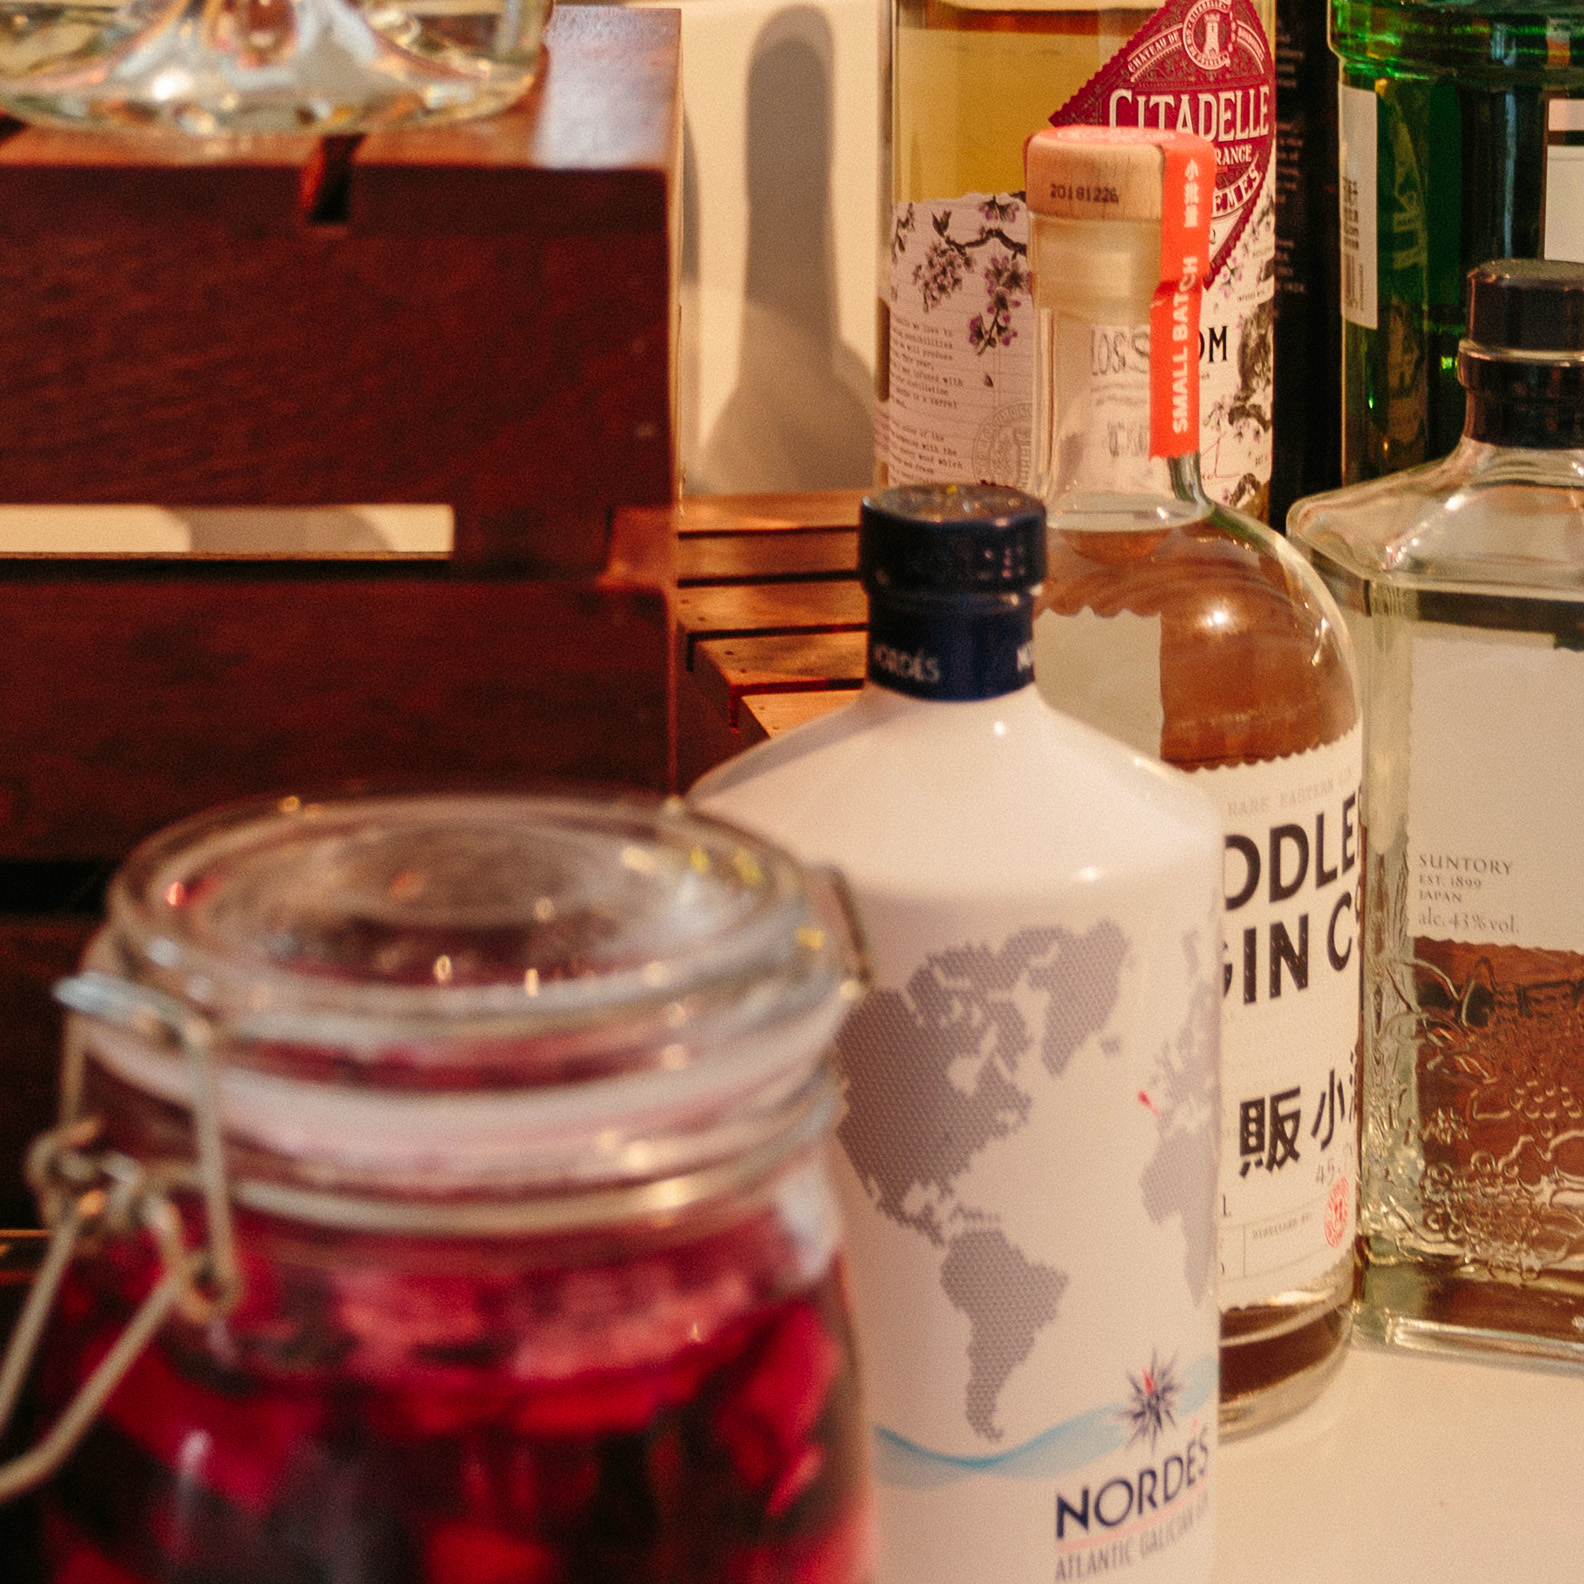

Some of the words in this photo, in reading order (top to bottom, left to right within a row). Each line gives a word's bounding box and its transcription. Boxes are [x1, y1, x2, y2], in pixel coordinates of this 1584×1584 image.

[1109, 85, 1270, 143] CITADELLE
[1171, 254, 1199, 343] BATCH
[1171, 347, 1192, 435] SMALL
[1418, 854, 1514, 876] SUNTORY
[1450, 875, 1482, 888] 1899
[1419, 890, 1463, 903] JAPAN
[1238, 1049, 1354, 1179] 販小
